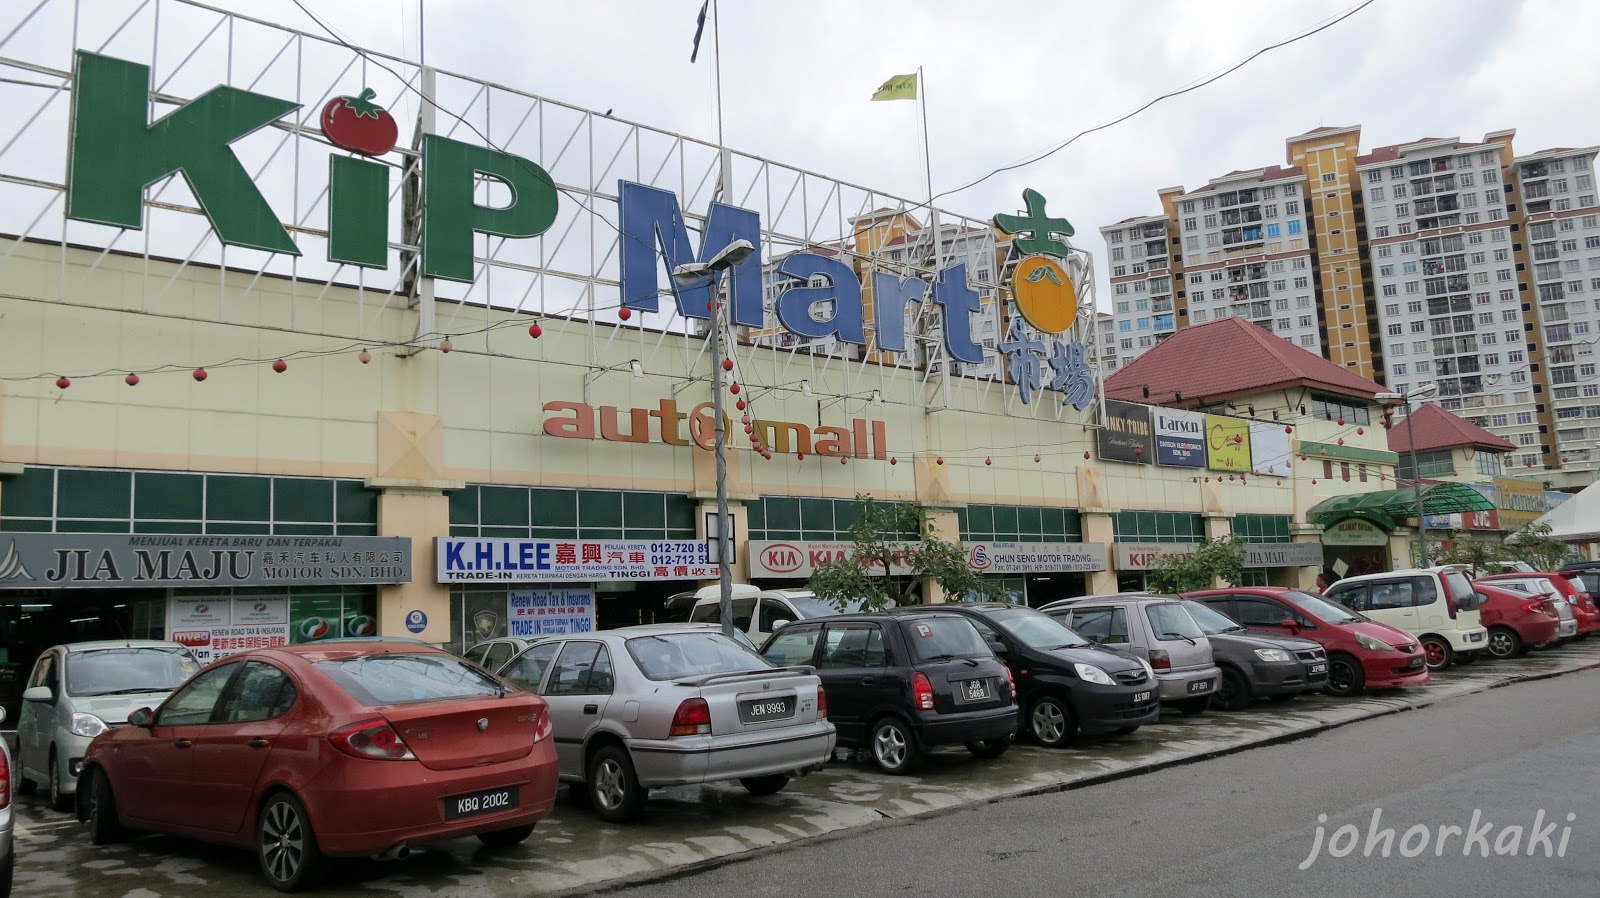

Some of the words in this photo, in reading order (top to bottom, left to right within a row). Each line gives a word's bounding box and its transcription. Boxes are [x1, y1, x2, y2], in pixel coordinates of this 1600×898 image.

[618, 179, 984, 364] Mart
[543, 398, 730, 451] auto
[752, 418, 887, 460] mall
[1105, 416, 1125, 433] UNKY
[1126, 419, 1148, 436] TRIBE
[1159, 415, 1199, 433] Darson
[1160, 440, 1176, 448] DARSON
[1473, 511, 1491, 528] JVC
[128, 537, 184, 547] MENJUAL
[187, 537, 230, 547] KERETA
[232, 537, 263, 547] BARU
[266, 537, 290, 547] DAN
[292, 538, 343, 547] TERPAKAI
[651, 543, 695, 553] 012-720
[262, 552, 404, 565] 嘉禾汽车私人有限公司
[446, 541, 551, 571] K.H.LEE
[555, 543, 602, 565] 嘉興
[606, 551, 645, 564] 汽車
[651, 555, 695, 565] 012-712
[768, 551, 797, 566] KIA
[994, 554, 1015, 563] CHUN
[1016, 554, 1036, 563] SENG
[1037, 554, 1062, 563] MOTOR
[1063, 554, 1092, 562] TRADING
[1249, 552, 1263, 564] JIA
[1264, 551, 1287, 564] MAJU
[45, 549, 123, 581] JIA
[133, 549, 256, 581] MAJU
[262, 566, 323, 579] MOTOR
[330, 566, 367, 579] SDN.
[369, 566, 407, 578] BHD.
[446, 572, 512, 580] TRADE-IN
[511, 592, 531, 607] Renew
[532, 592, 547, 607] Road
[548, 592, 559, 606] Tax
[560, 591, 565, 606] &
[566, 591, 591, 606] Insurans
[231, 628, 245, 636] ROAD
[261, 627, 285, 635] INSURANS
[512, 620, 532, 636] TRADE
[534, 619, 541, 634] IN
[569, 618, 591, 633] TINGGI
[917, 625, 930, 637] P
[969, 688, 985, 698] 5468
[750, 703, 765, 716] JEN
[766, 702, 786, 714] 9993
[458, 797, 479, 813] KBQ
[483, 792, 509, 809] 2002
